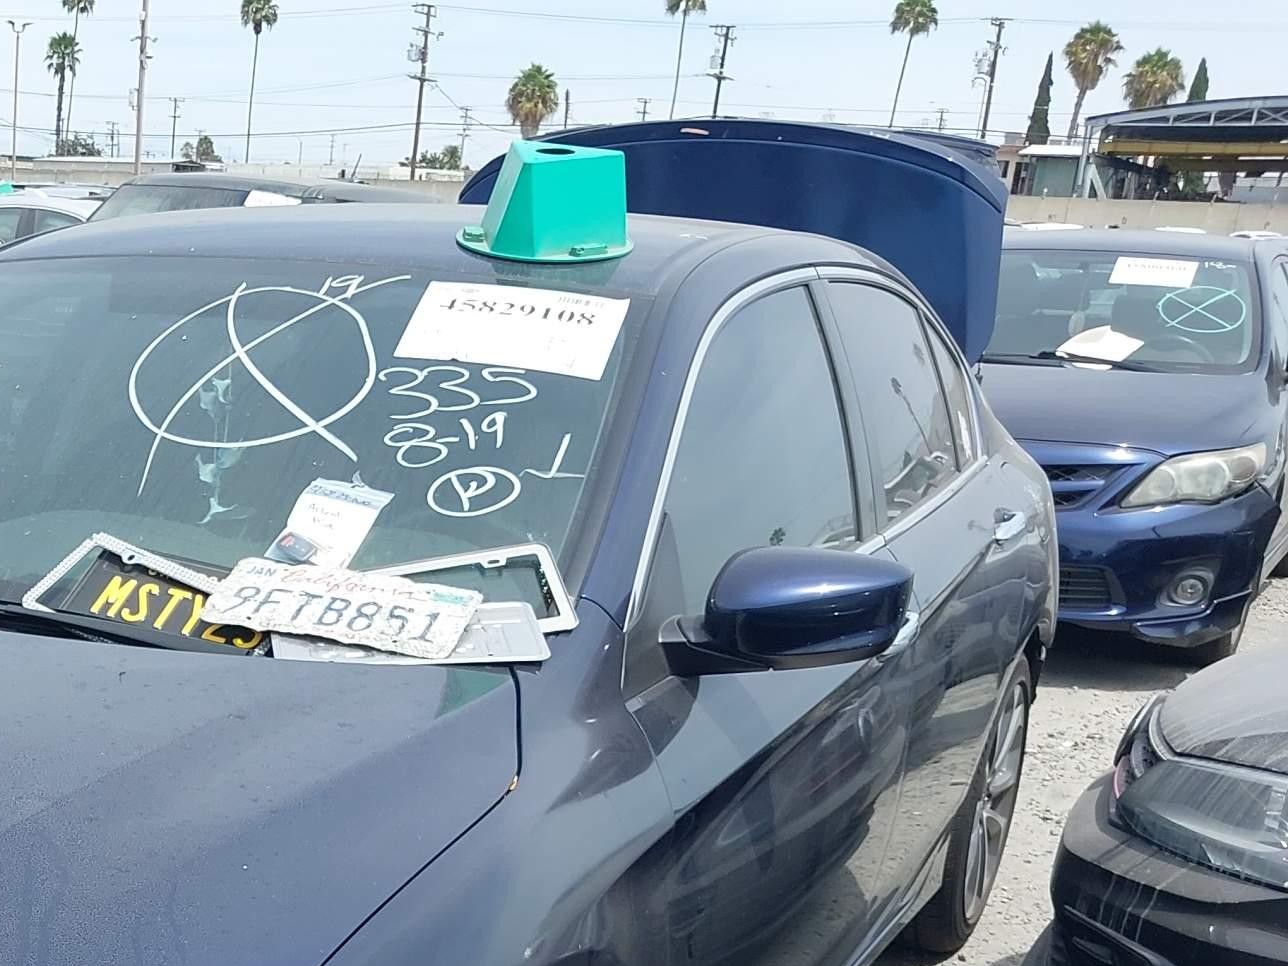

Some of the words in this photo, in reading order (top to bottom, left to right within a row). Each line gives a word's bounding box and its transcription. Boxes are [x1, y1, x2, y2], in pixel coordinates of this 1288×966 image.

[439, 298, 596, 326] 45829108
[378, 365, 539, 420] 335
[383, 410, 508, 468] 8-19
[245, 565, 278, 577] JAN
[220, 585, 442, 644] 9FTB851
